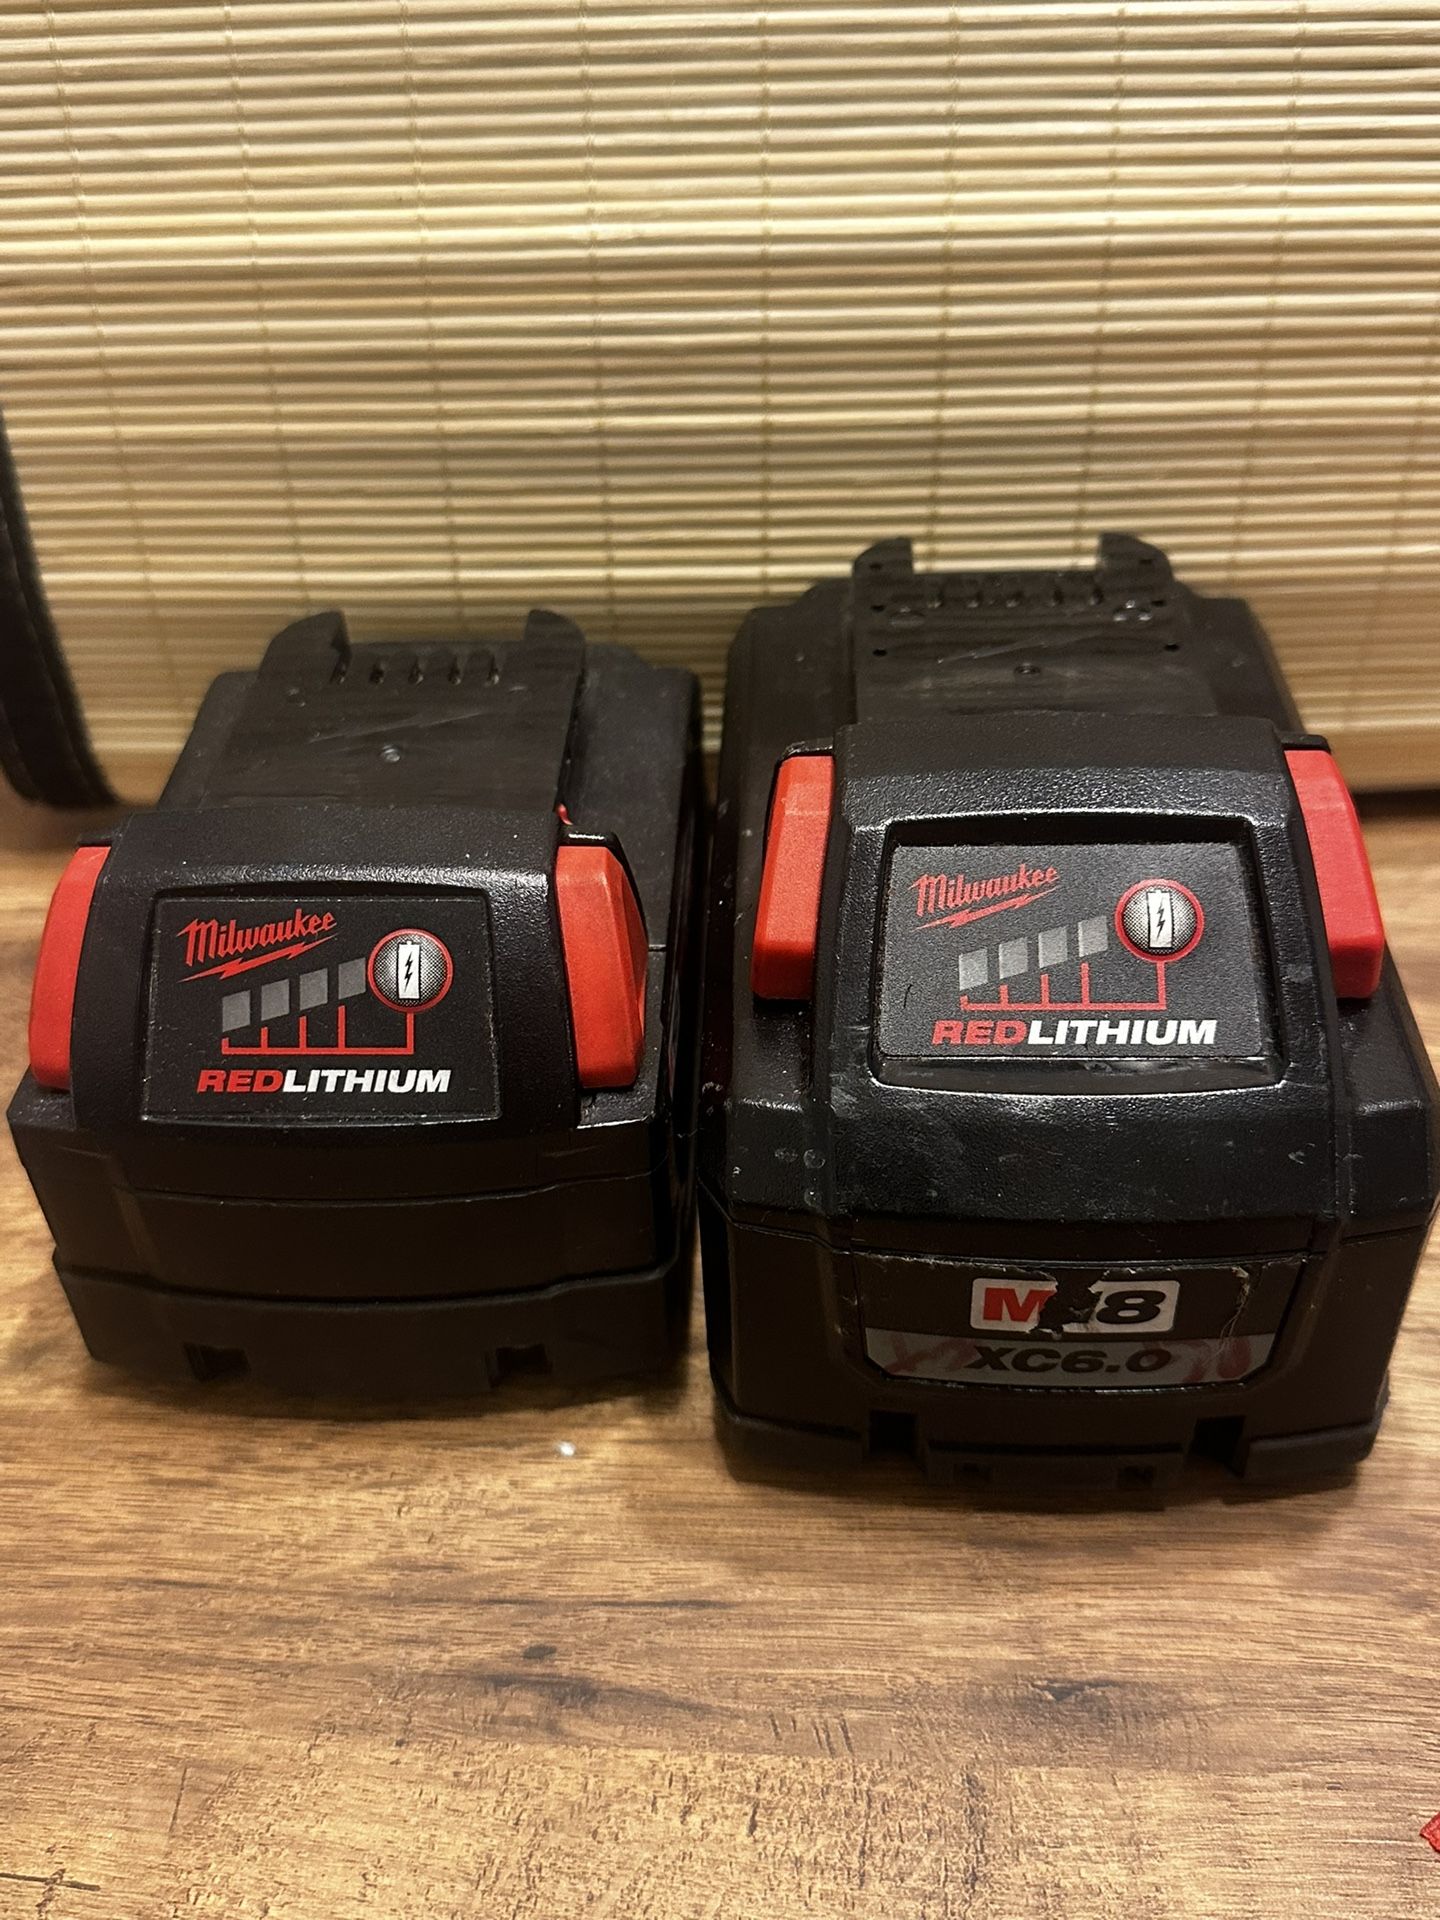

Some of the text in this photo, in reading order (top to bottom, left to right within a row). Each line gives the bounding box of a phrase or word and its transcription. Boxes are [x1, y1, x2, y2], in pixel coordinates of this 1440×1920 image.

[909, 864, 1060, 916] Milwaukee
[177, 908, 337, 966] Milwaukee
[932, 1020, 1217, 1046] REDLITHIUM
[198, 1069, 451, 1094] REDLITHIUM
[983, 1287, 1166, 1324] M8
[965, 1346, 1171, 1374] XC6.0
